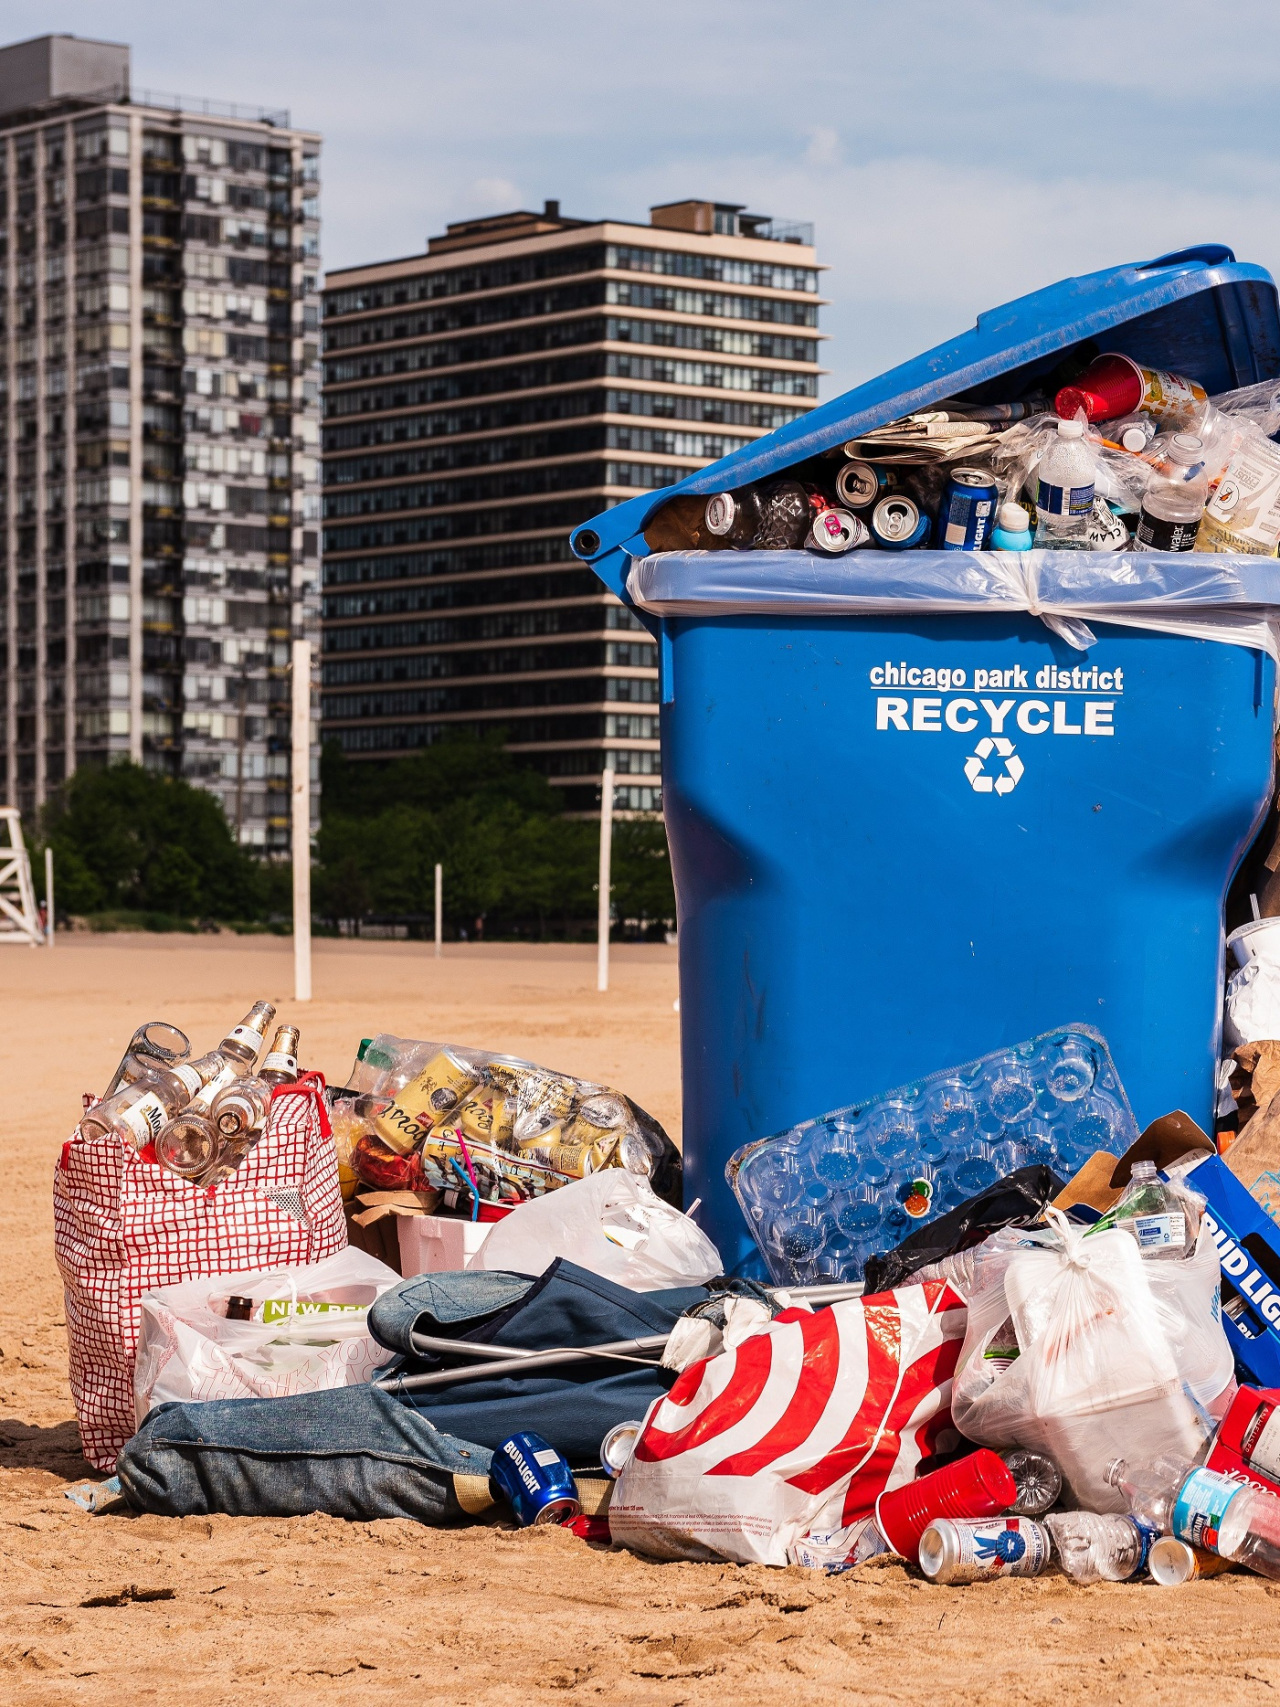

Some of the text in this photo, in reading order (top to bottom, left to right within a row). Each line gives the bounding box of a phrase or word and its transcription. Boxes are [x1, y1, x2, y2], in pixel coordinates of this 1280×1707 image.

[1089, 527, 1122, 543] CLAW
[869, 661, 1123, 693] chicago park district
[876, 696, 1115, 736] RECYCLE
[503, 1440, 541, 1496] BUD LIGHT
[1029, 1523, 1041, 1541] BLUE
[1031, 1543, 1043, 1573] RIBBON
